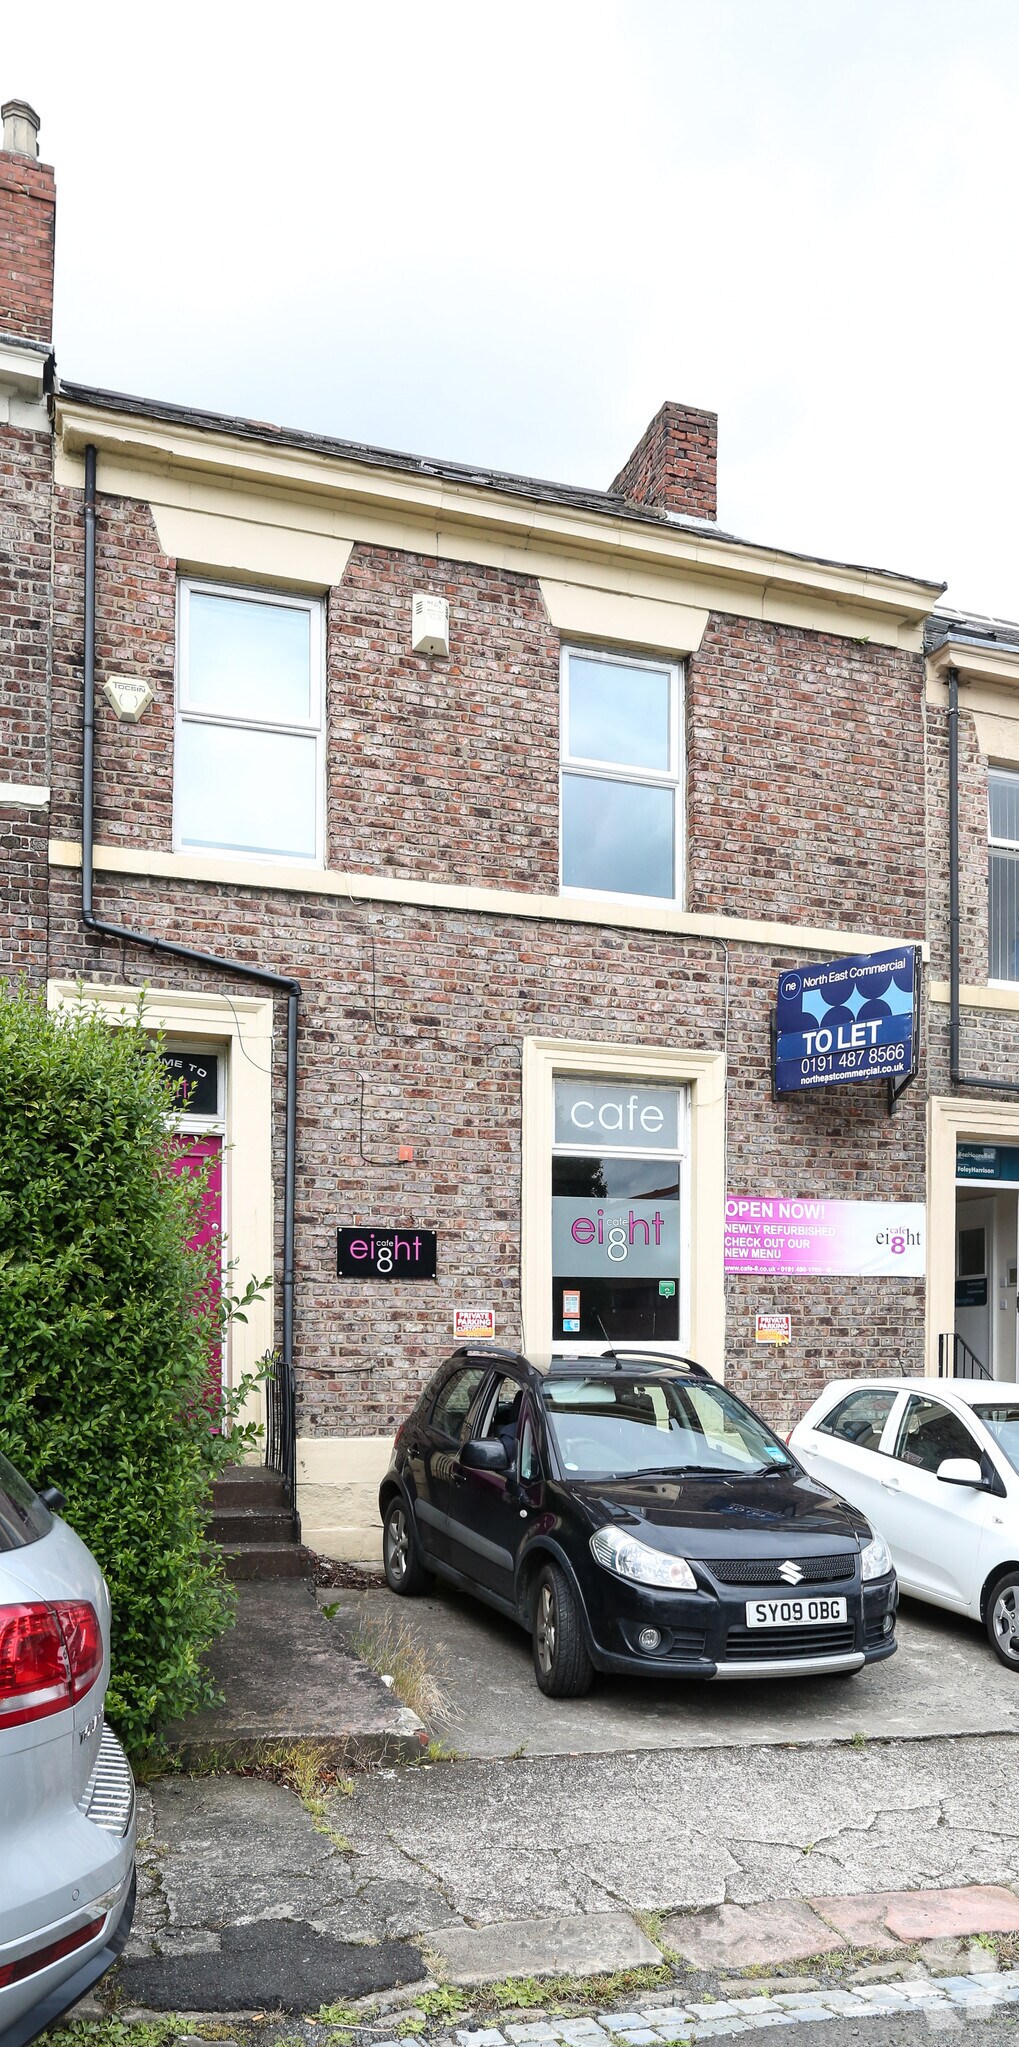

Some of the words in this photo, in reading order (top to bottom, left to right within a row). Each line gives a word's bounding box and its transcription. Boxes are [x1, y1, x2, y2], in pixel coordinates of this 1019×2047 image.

[112, 681, 146, 693] TOCSIN
[803, 976, 828, 988] North
[828, 971, 848, 982] East
[850, 958, 906, 978] Commercial
[785, 982, 796, 992] ne
[802, 1028, 832, 1055] TO
[838, 1020, 882, 1050] LET
[801, 1056, 833, 1074] 0191
[838, 1050, 864, 1068] 487
[868, 1044, 905, 1064] 8566
[189, 1063, 208, 1078] TO
[800, 1062, 904, 1085] northeastcommercial.co.uk
[570, 1095, 664, 1132] cafe
[958, 1166, 994, 1174] FoleyHarrison
[725, 1200, 773, 1218] OPEN
[779, 1203, 825, 1220] NOW!
[606, 1216, 628, 1226] cafe
[725, 1224, 761, 1234] NEWLY
[763, 1224, 836, 1236] REFURBISHED
[376, 1239, 394, 1248] cafe
[725, 1237, 761, 1248] CHECK
[764, 1238, 785, 1248] OUT
[788, 1238, 810, 1249] OUR
[725, 1248, 749, 1258] NEW
[752, 1249, 782, 1259] MENU
[459, 1312, 490, 1320] PRIVATE
[756, 1602, 803, 1622] SY09
[808, 1600, 840, 1620] OBG
